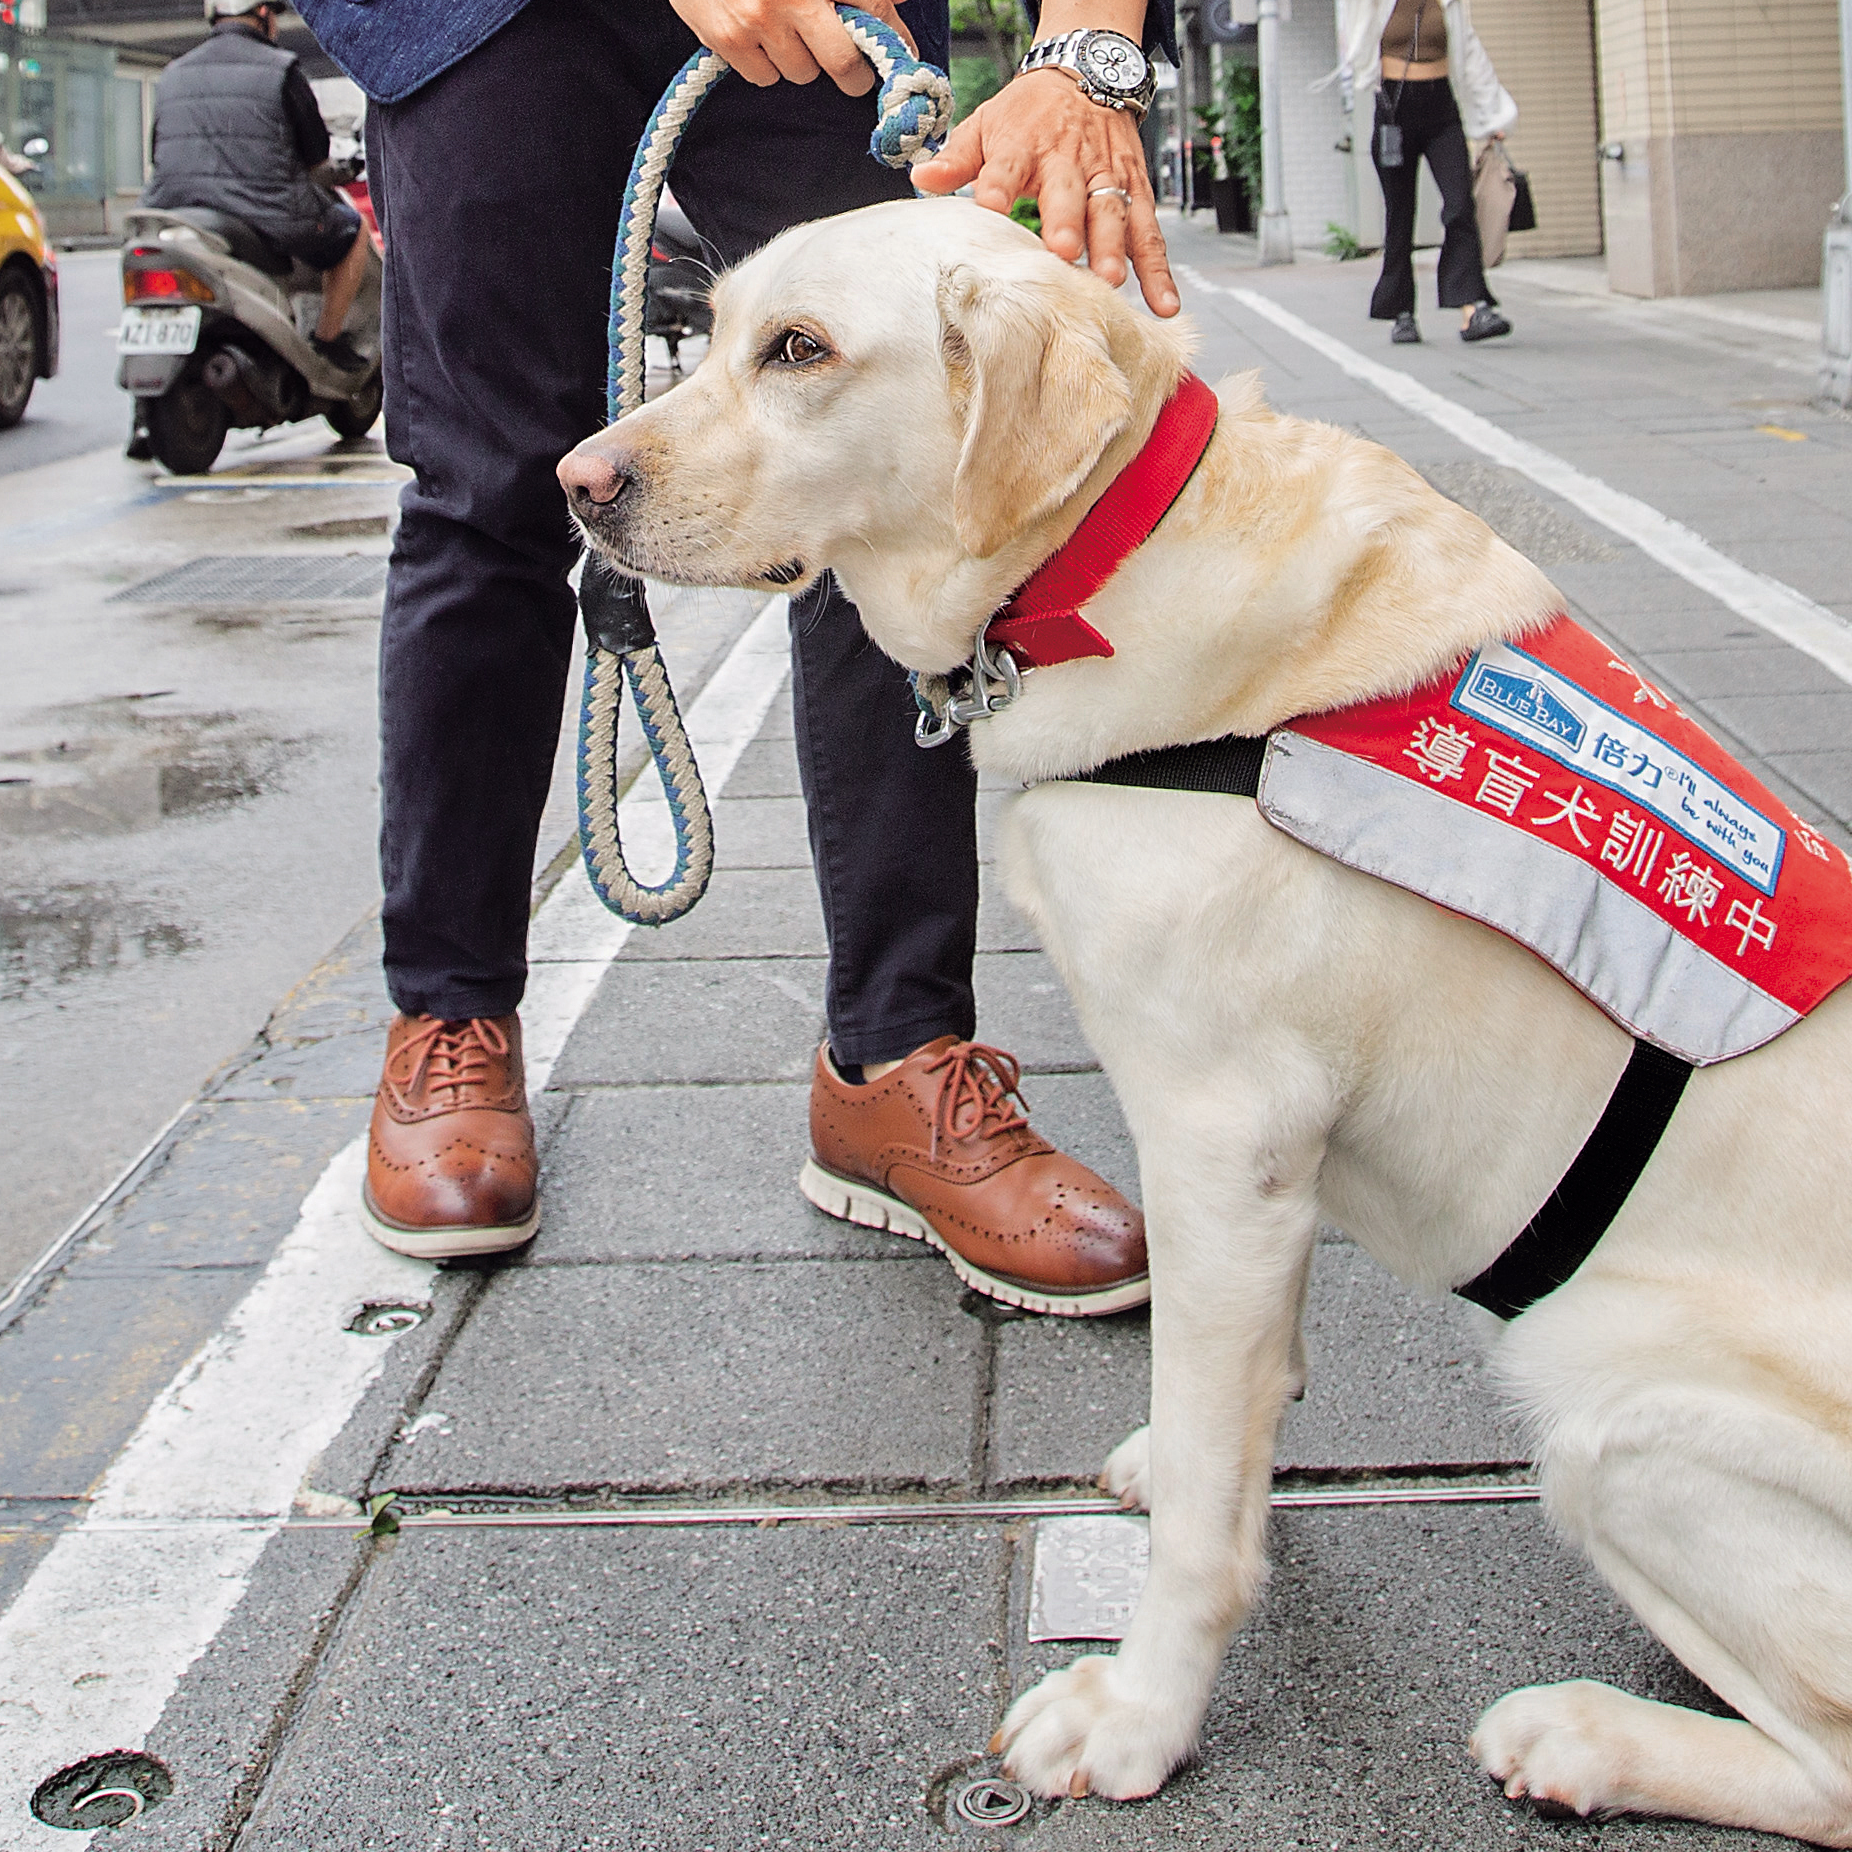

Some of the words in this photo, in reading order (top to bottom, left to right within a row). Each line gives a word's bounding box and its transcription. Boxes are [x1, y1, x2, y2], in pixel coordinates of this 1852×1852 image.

[1478, 676, 1531, 715] BLUE
[1531, 705, 1572, 737] BAY
[1402, 715, 1778, 958] 導盲犬訓練中
[1681, 796, 1700, 821] be
[1706, 819, 1737, 849] with
[1741, 848, 1770, 875] you
[1703, 799, 1757, 843] always
